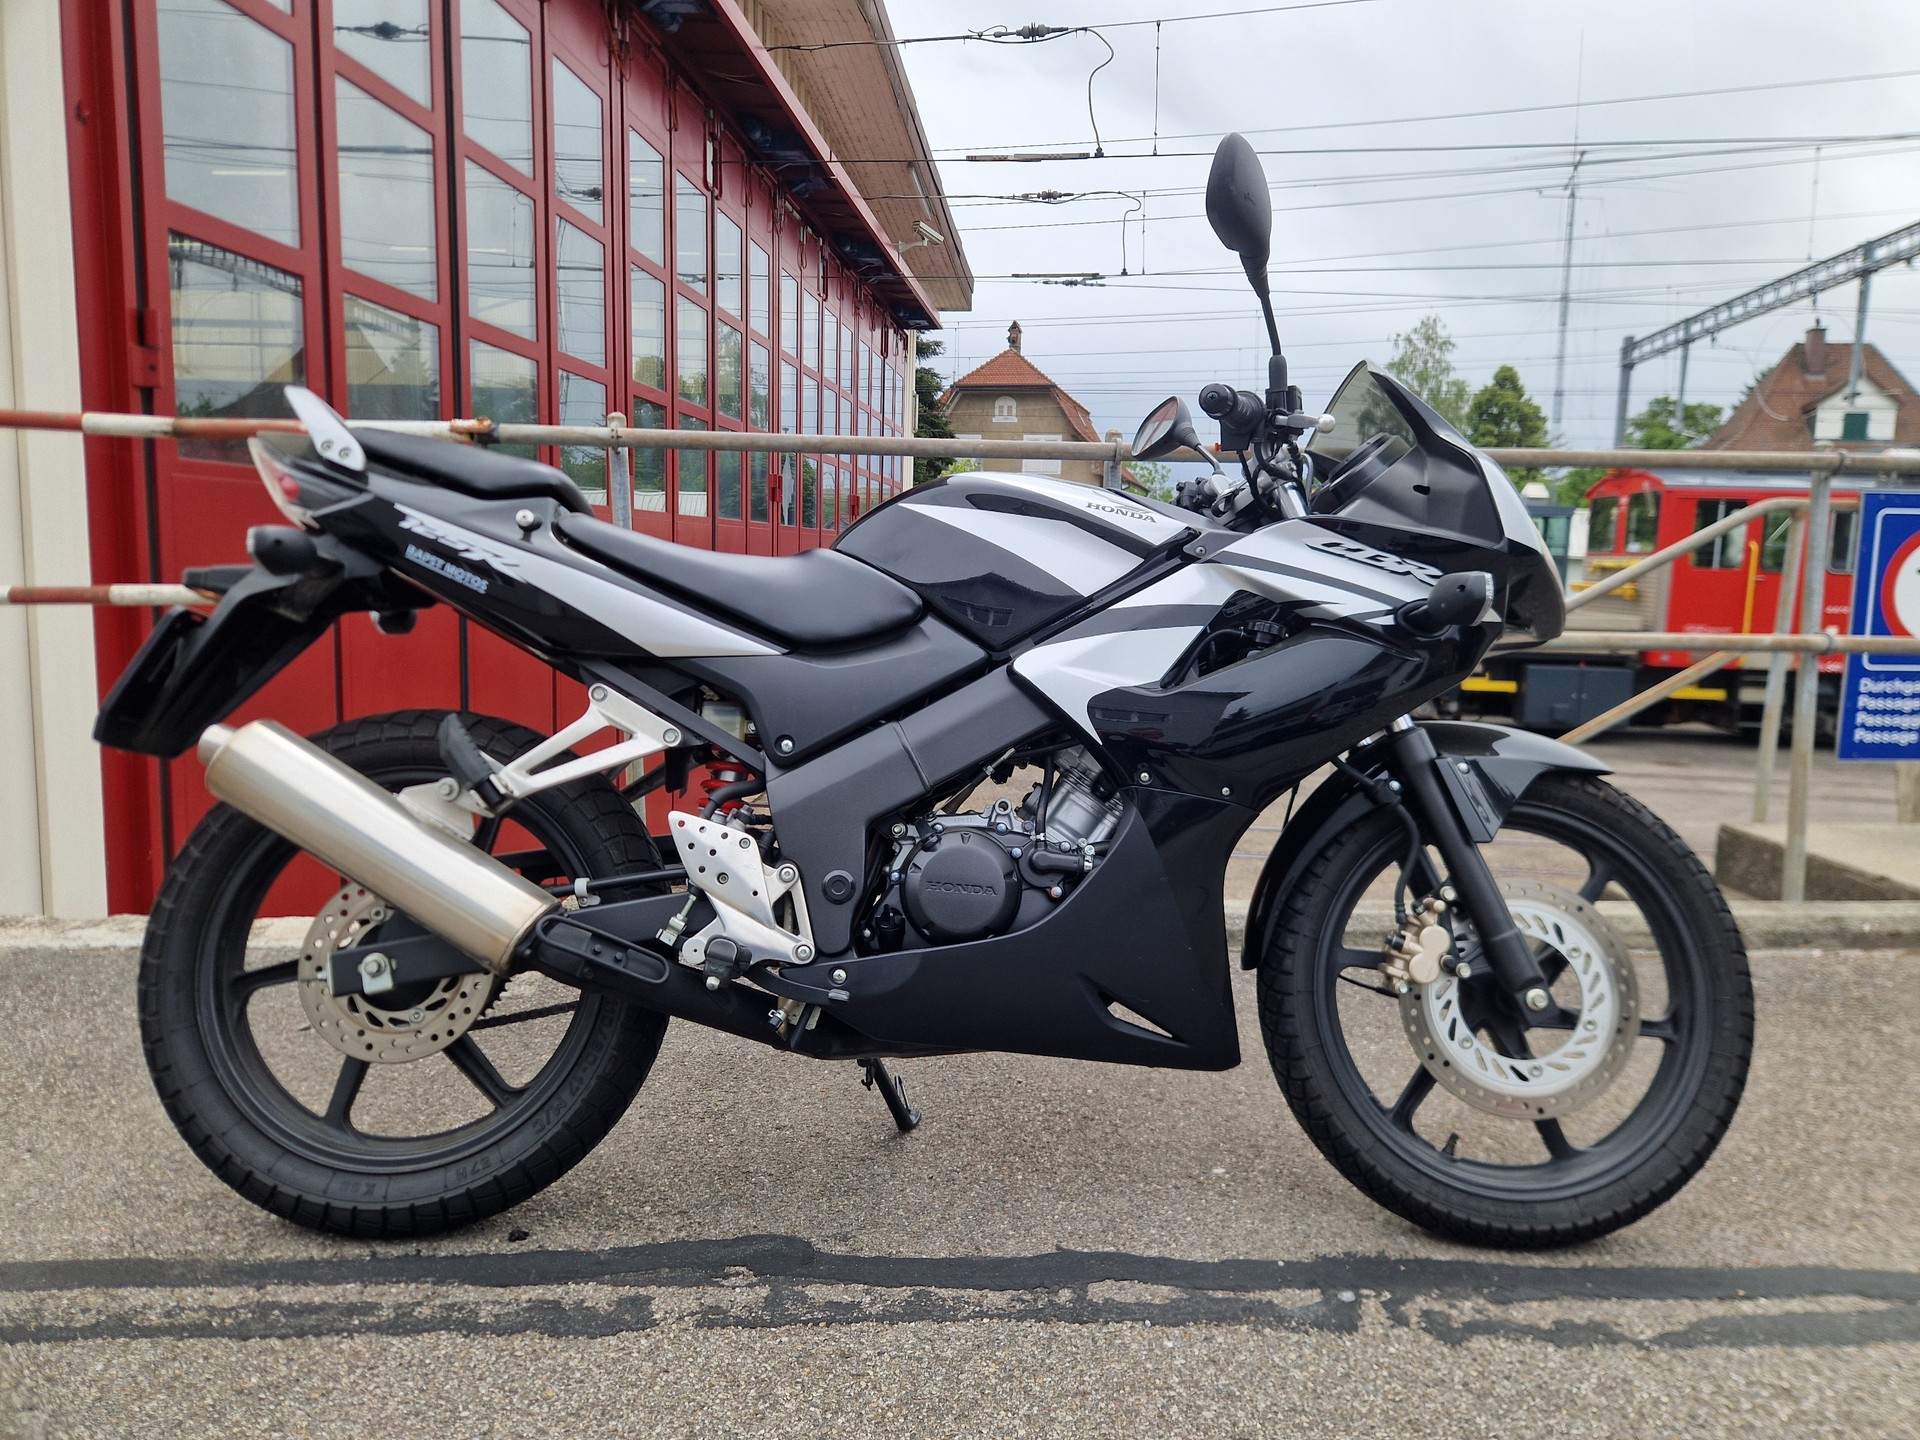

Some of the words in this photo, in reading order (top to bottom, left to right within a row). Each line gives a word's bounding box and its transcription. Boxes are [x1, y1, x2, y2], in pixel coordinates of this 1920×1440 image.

[1086, 502, 1157, 524] HONDA
[1302, 537, 1443, 587] CBR
[444, 562, 489, 590] MOTOS
[1853, 727, 1919, 747] Passage
[926, 880, 998, 897] HONDA
